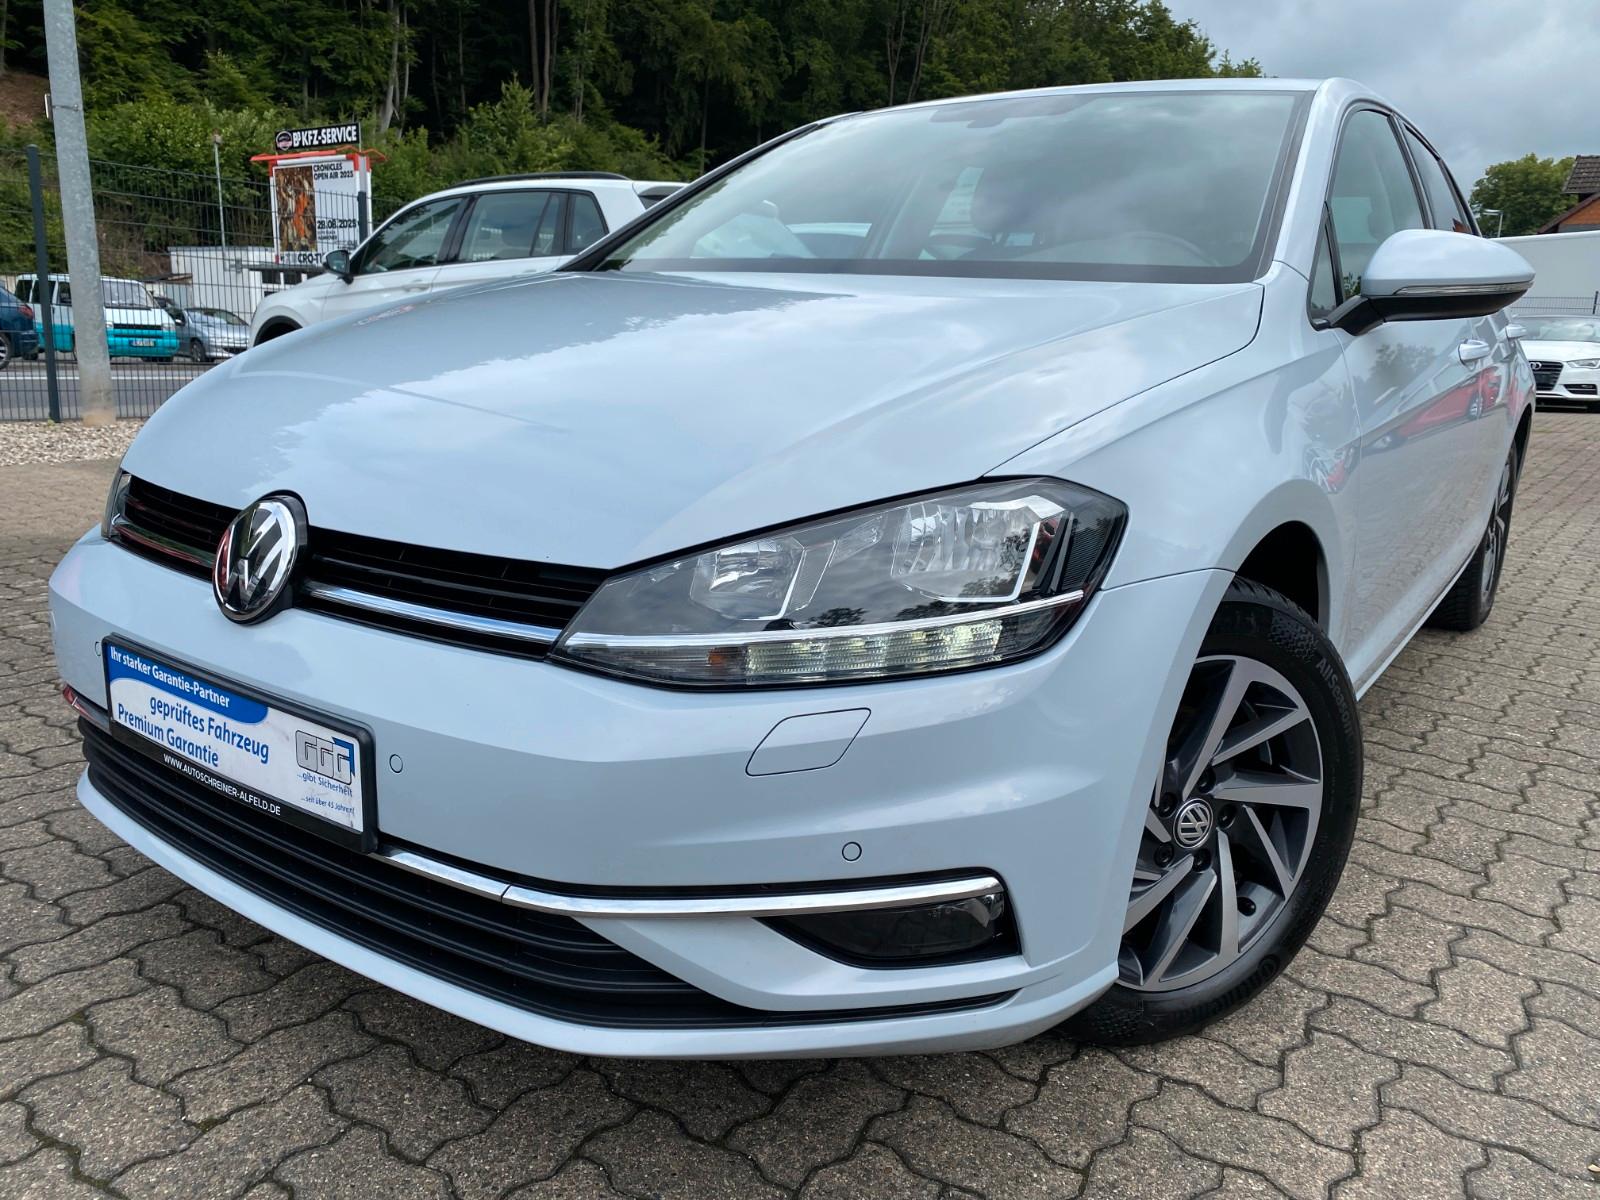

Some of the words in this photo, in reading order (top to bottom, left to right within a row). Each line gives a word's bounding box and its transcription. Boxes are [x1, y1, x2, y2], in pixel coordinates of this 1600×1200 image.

[302, 125, 357, 146] KFZ-SERVICE
[330, 171, 338, 179] AIR
[340, 170, 354, 178] 2025
[110, 646, 122, 663] Ihr
[123, 654, 151, 675] starker
[152, 665, 230, 708] Garantie-Partner
[118, 703, 164, 742] Premium
[166, 728, 219, 767] Garantie
[150, 697, 205, 733] geprüftes
[207, 717, 269, 765] Fahrzeug
[163, 754, 281, 816] WWW.AUTOSCHREINER-ALFELD.DE
[318, 776, 353, 797] Sicherheit
